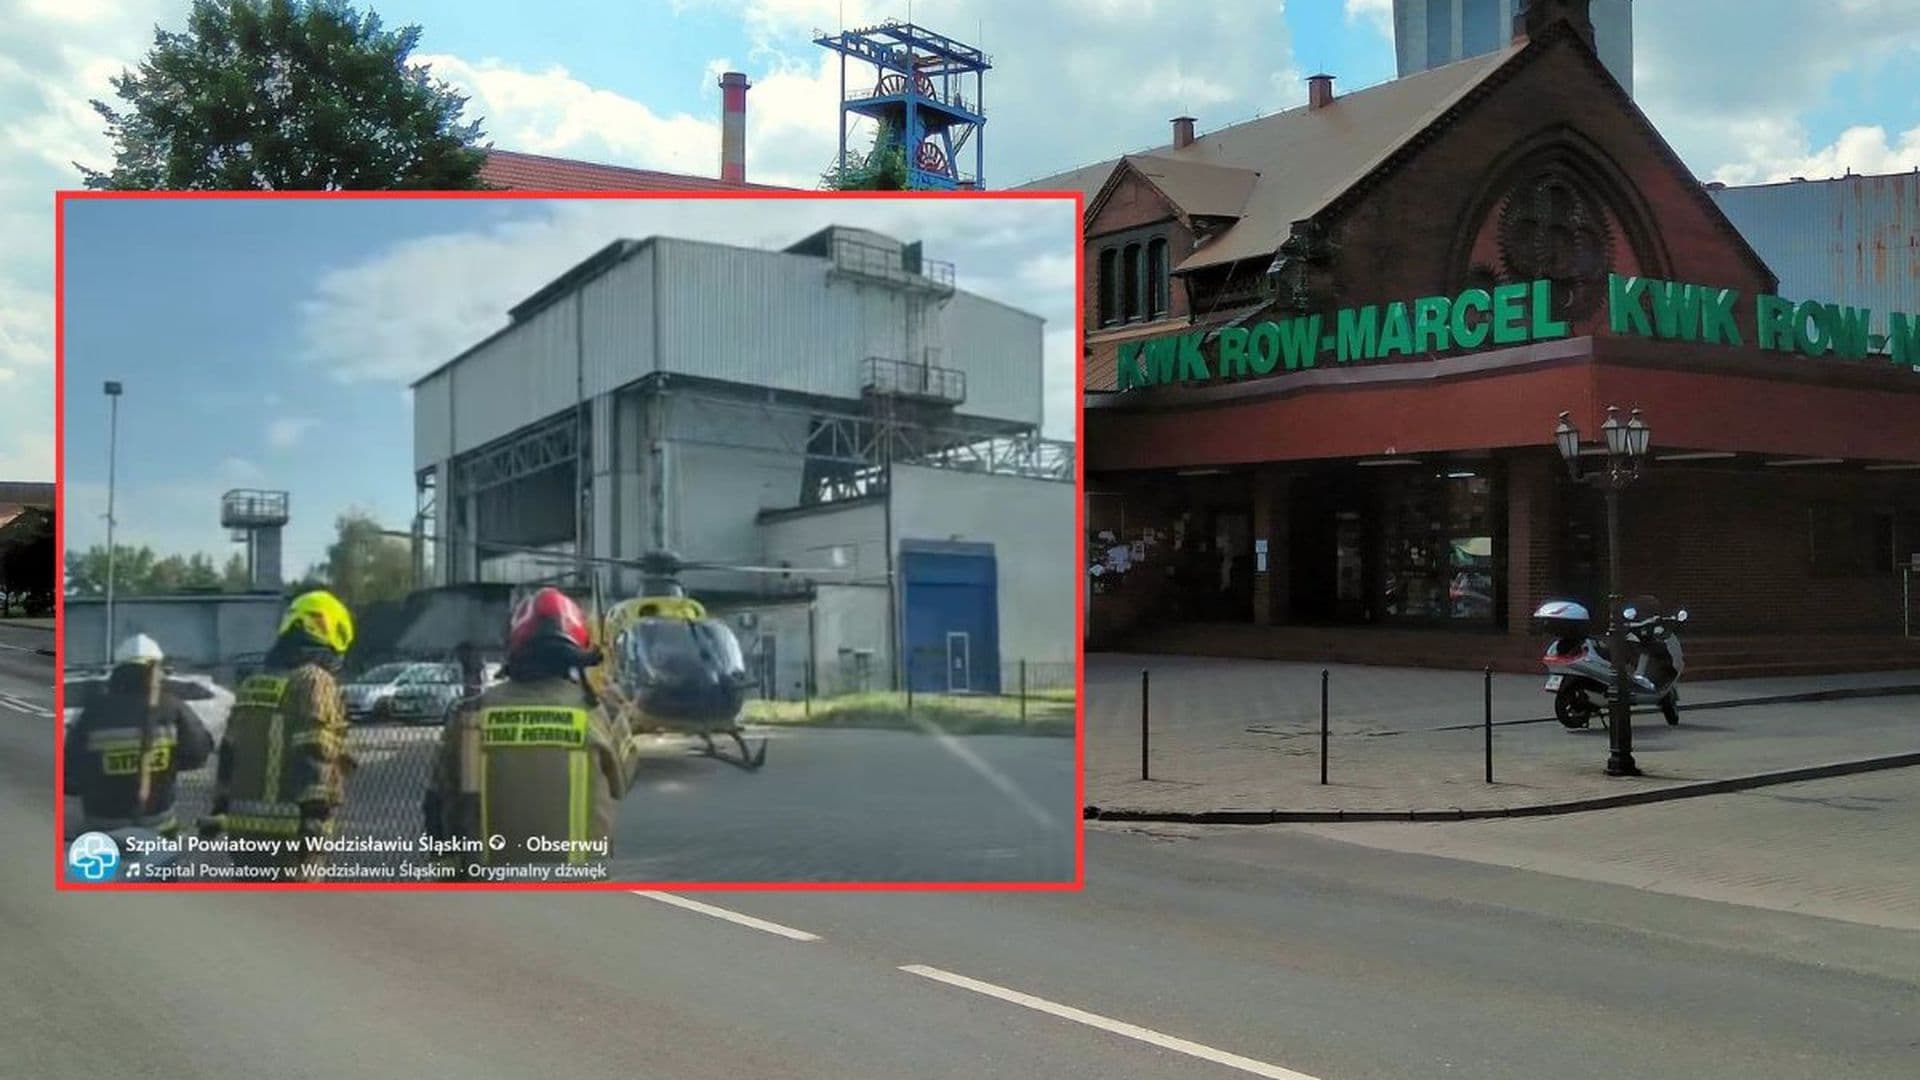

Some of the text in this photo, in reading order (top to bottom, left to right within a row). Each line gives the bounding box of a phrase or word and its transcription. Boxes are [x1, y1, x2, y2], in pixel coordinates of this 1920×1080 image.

[1117, 279, 1569, 391] KWK ROW-MARCEL
[1609, 272, 1744, 347] KWK
